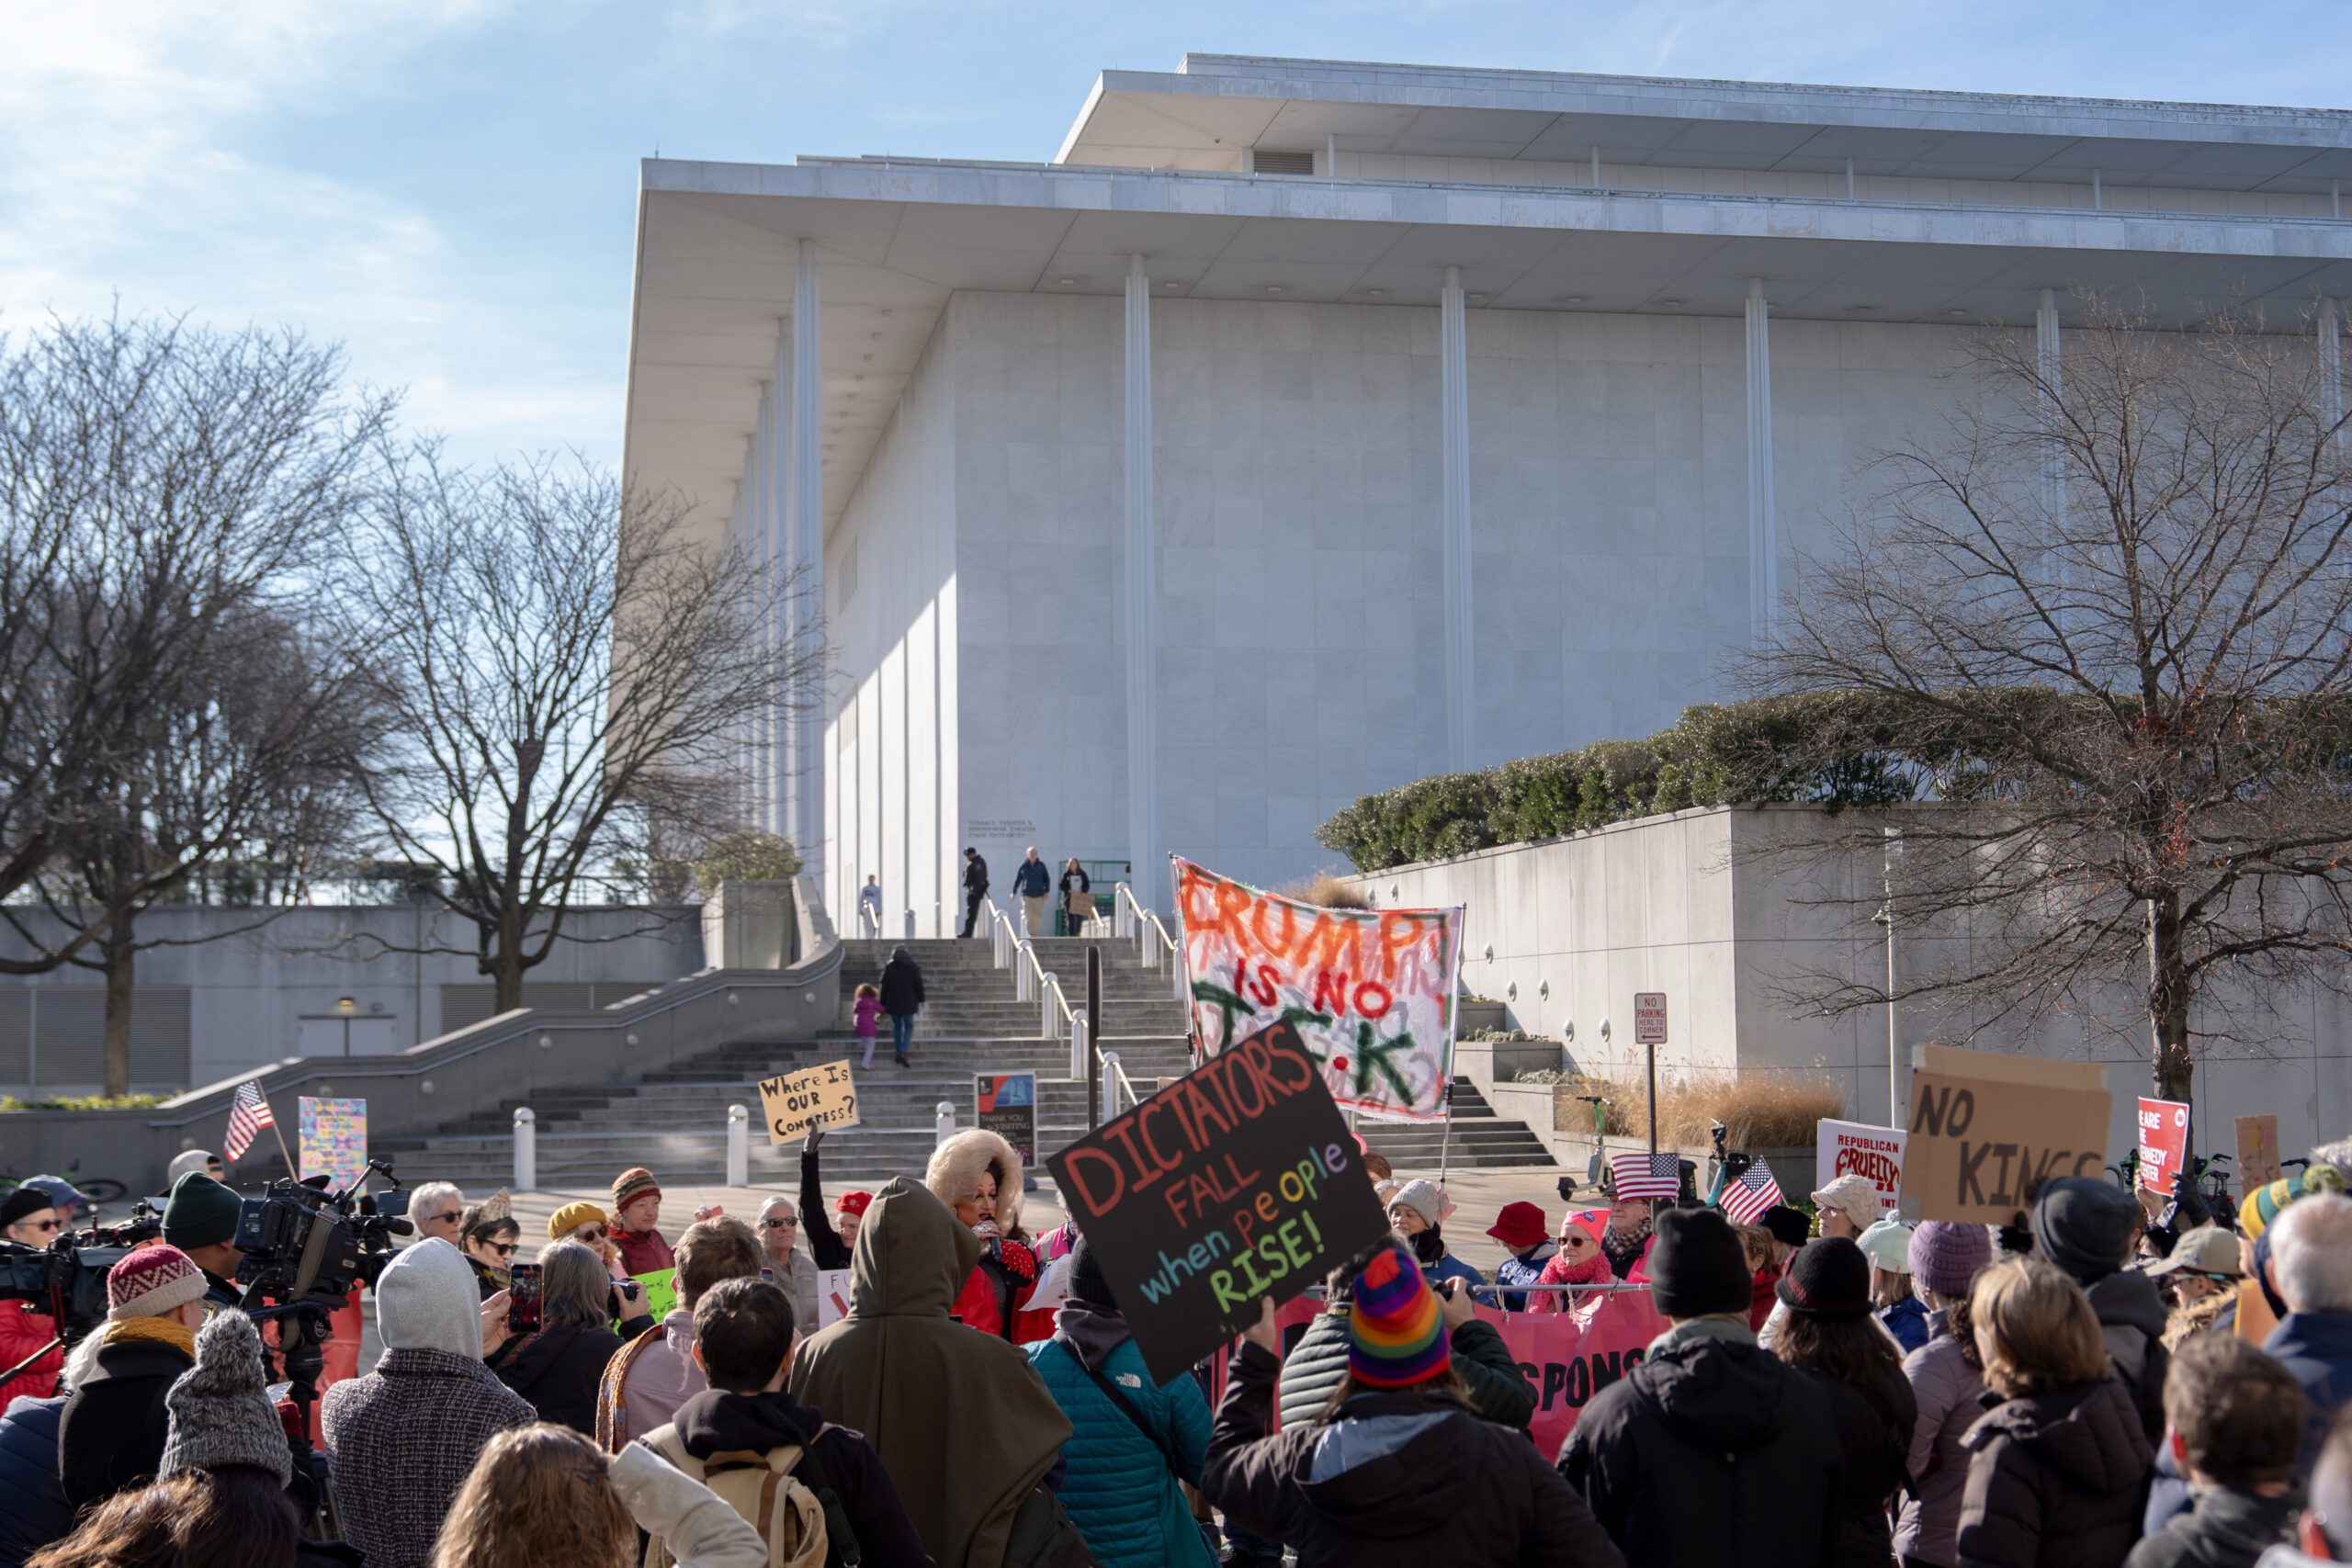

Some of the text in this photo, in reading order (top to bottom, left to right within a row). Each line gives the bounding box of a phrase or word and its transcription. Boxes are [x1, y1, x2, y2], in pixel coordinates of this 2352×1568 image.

[1181, 867, 1422, 981] TRUMP
[1234, 957, 1392, 1020] IS NO
[1645, 998, 1657, 1008] NO
[1637, 1009, 1665, 1019] PARKING
[761, 1066, 849, 1100] Where Is
[786, 1091, 821, 1112] OUR
[1007, 1114, 1024, 1122] YOU
[1064, 1024, 1313, 1217] DICTATORS
[1913, 1084, 1974, 1138] NO
[2138, 1110, 2162, 1130] E ARE
[1838, 1134, 1899, 1154] REPUBLICAN
[2139, 1144, 2168, 1167] ENNEDY
[1836, 1147, 1901, 1192] CRUELTY
[1958, 1141, 2102, 1208] KIN
[1164, 1154, 1261, 1229] FALL
[1880, 1197, 1896, 1210] INT
[1140, 1143, 1348, 1305] when people
[1209, 1210, 1325, 1314] RISE!
